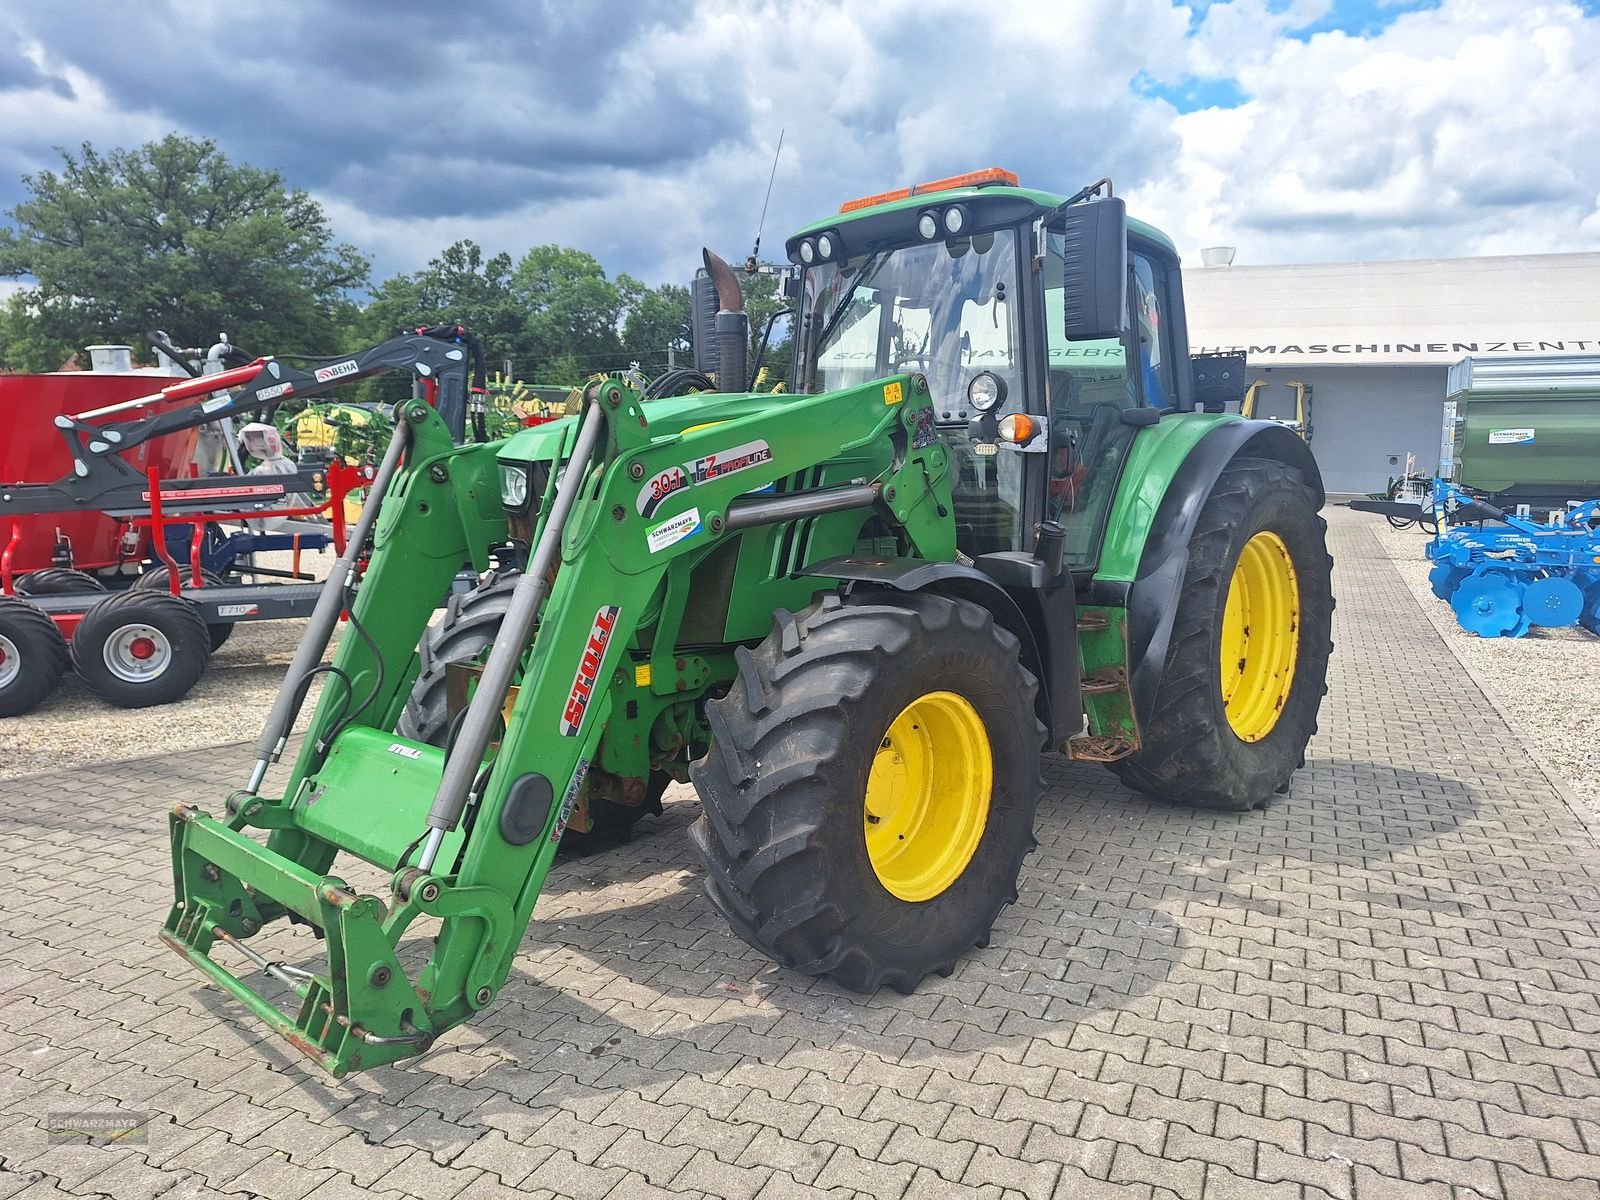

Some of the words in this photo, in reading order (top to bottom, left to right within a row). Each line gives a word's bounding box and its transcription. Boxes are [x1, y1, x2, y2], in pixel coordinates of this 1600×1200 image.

[332, 362, 357, 376] BEHA
[257, 386, 283, 400] 6550
[650, 469, 681, 500] 30.1
[695, 455, 718, 482] FZ
[652, 517, 692, 538] SCHWARZMAYR
[229, 606, 246, 614] 710
[564, 612, 615, 729] STOLL
[388, 743, 422, 760] STOLL
